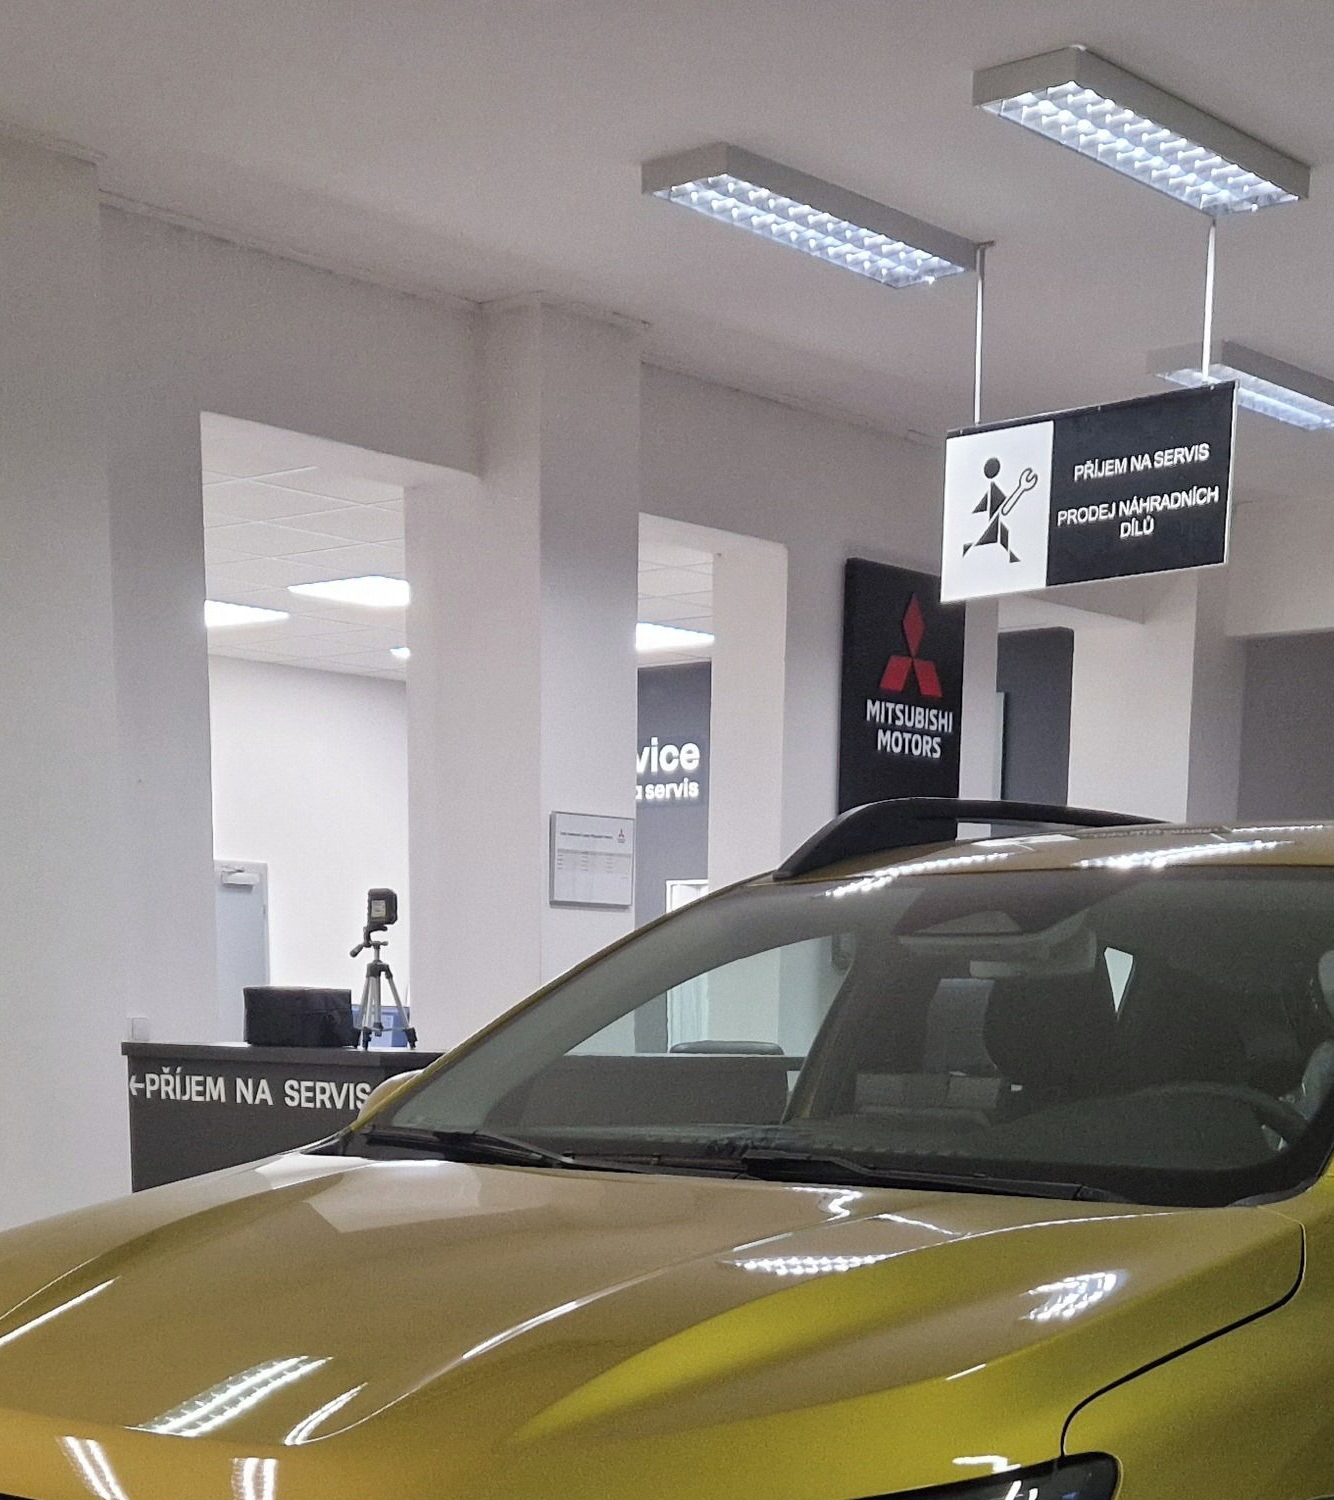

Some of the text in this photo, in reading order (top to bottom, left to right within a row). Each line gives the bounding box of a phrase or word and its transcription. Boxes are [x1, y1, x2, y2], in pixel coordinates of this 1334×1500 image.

[1074, 443, 1210, 481] PŘÍJEM NA SERVIS
[1057, 485, 1219, 526] PRODEJ NÁHRADNÍCH
[1120, 516, 1155, 539] DÍLŮ
[866, 698, 953, 733] MITSUBISHI
[877, 728, 942, 759] MOTORS
[645, 777, 700, 801] servis
[145, 1066, 371, 1111] PŘÍJEM NA SERVIS
